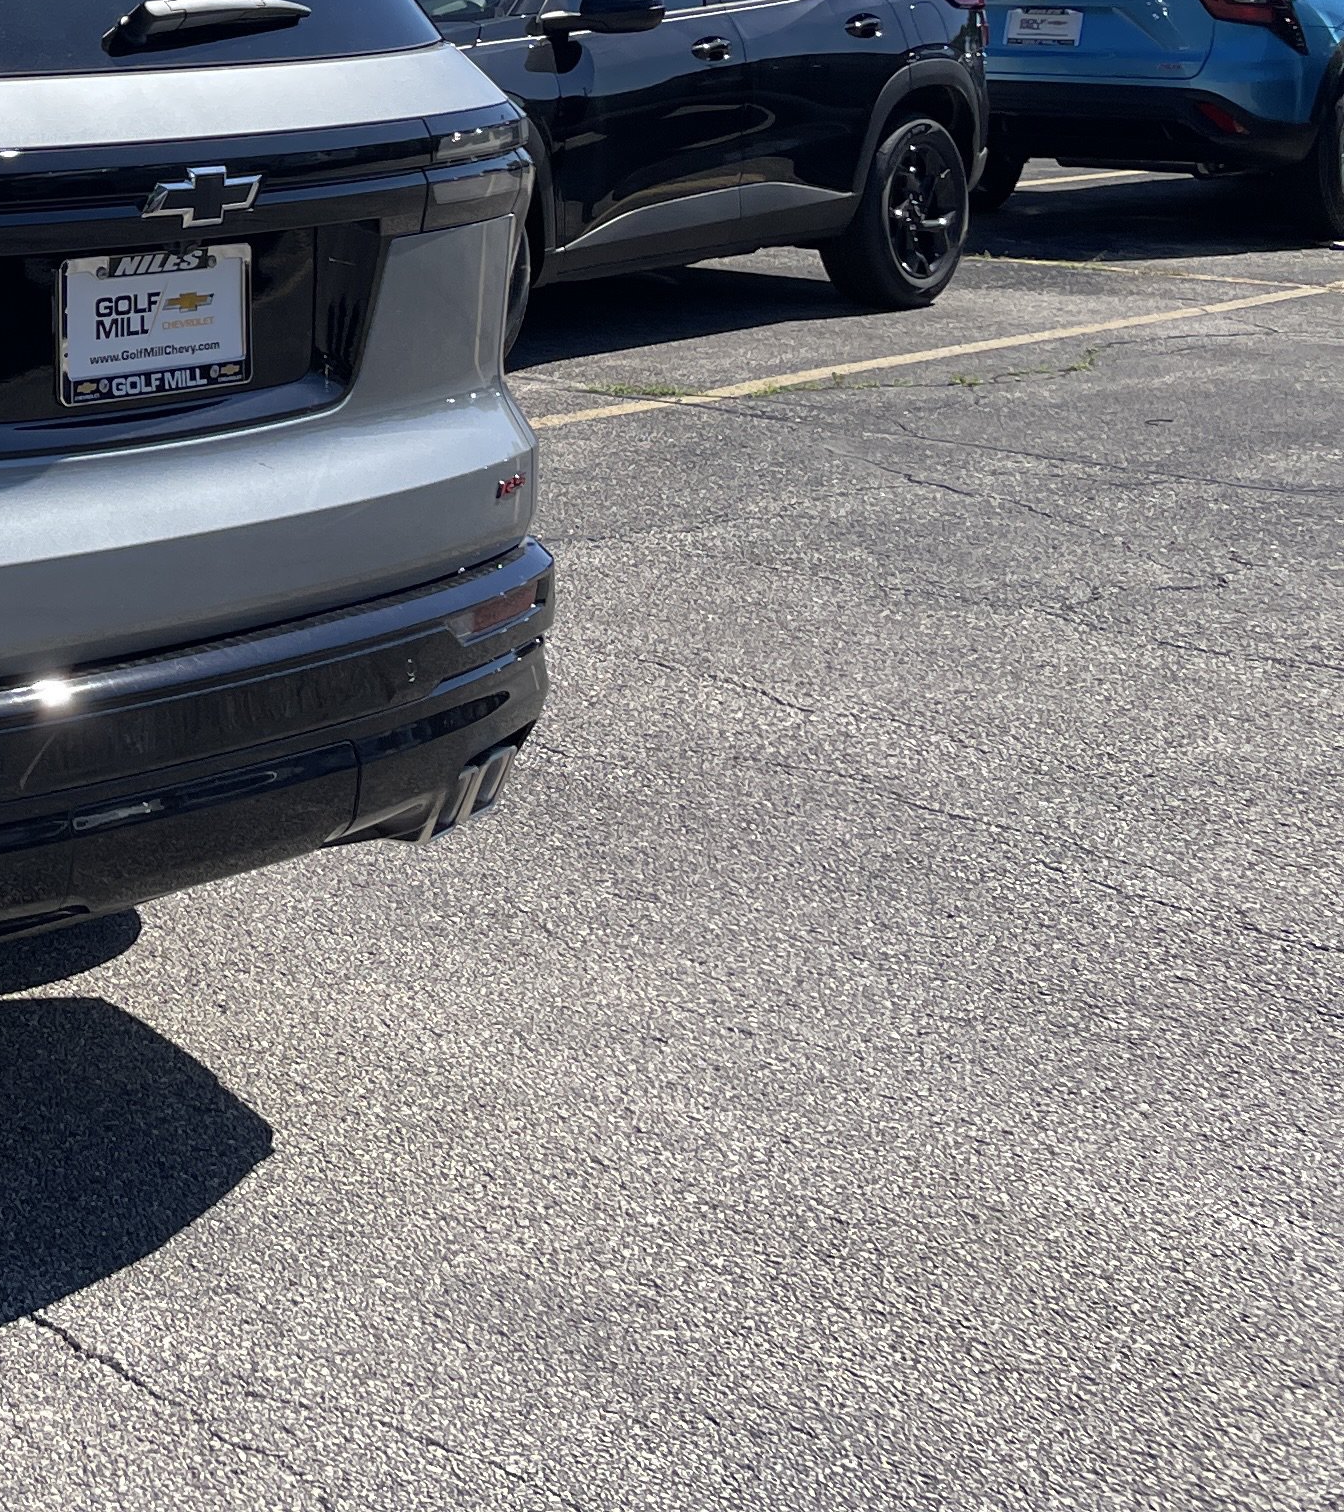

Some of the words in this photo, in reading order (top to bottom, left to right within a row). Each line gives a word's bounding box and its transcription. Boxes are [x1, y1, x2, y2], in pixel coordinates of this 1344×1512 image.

[113, 249, 204, 277] NILES
[95, 291, 161, 318] GOLF
[95, 315, 150, 340] MILL
[162, 315, 214, 330] CHEVROLET
[89, 341, 220, 365] www.GolfMillChevy.com
[112, 373, 161, 396] GOLF
[164, 367, 208, 390] MILL
